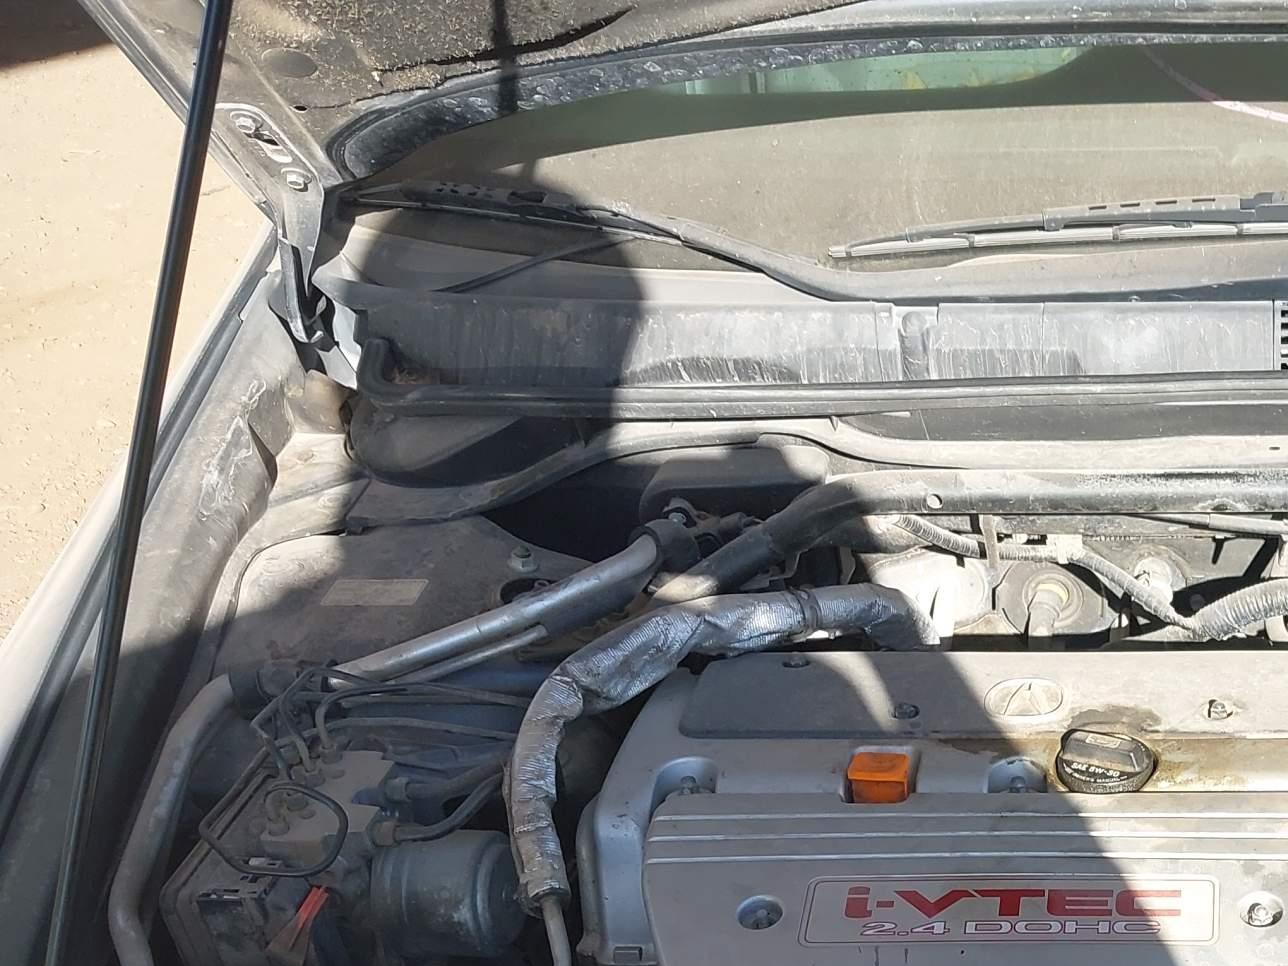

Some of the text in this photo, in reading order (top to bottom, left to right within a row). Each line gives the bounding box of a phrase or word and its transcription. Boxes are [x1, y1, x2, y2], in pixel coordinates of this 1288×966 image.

[1070, 762, 1120, 778] SAE 5W-30
[844, 886, 1182, 919] i-VTEC
[860, 919, 1161, 936] 2.4 DOHC
